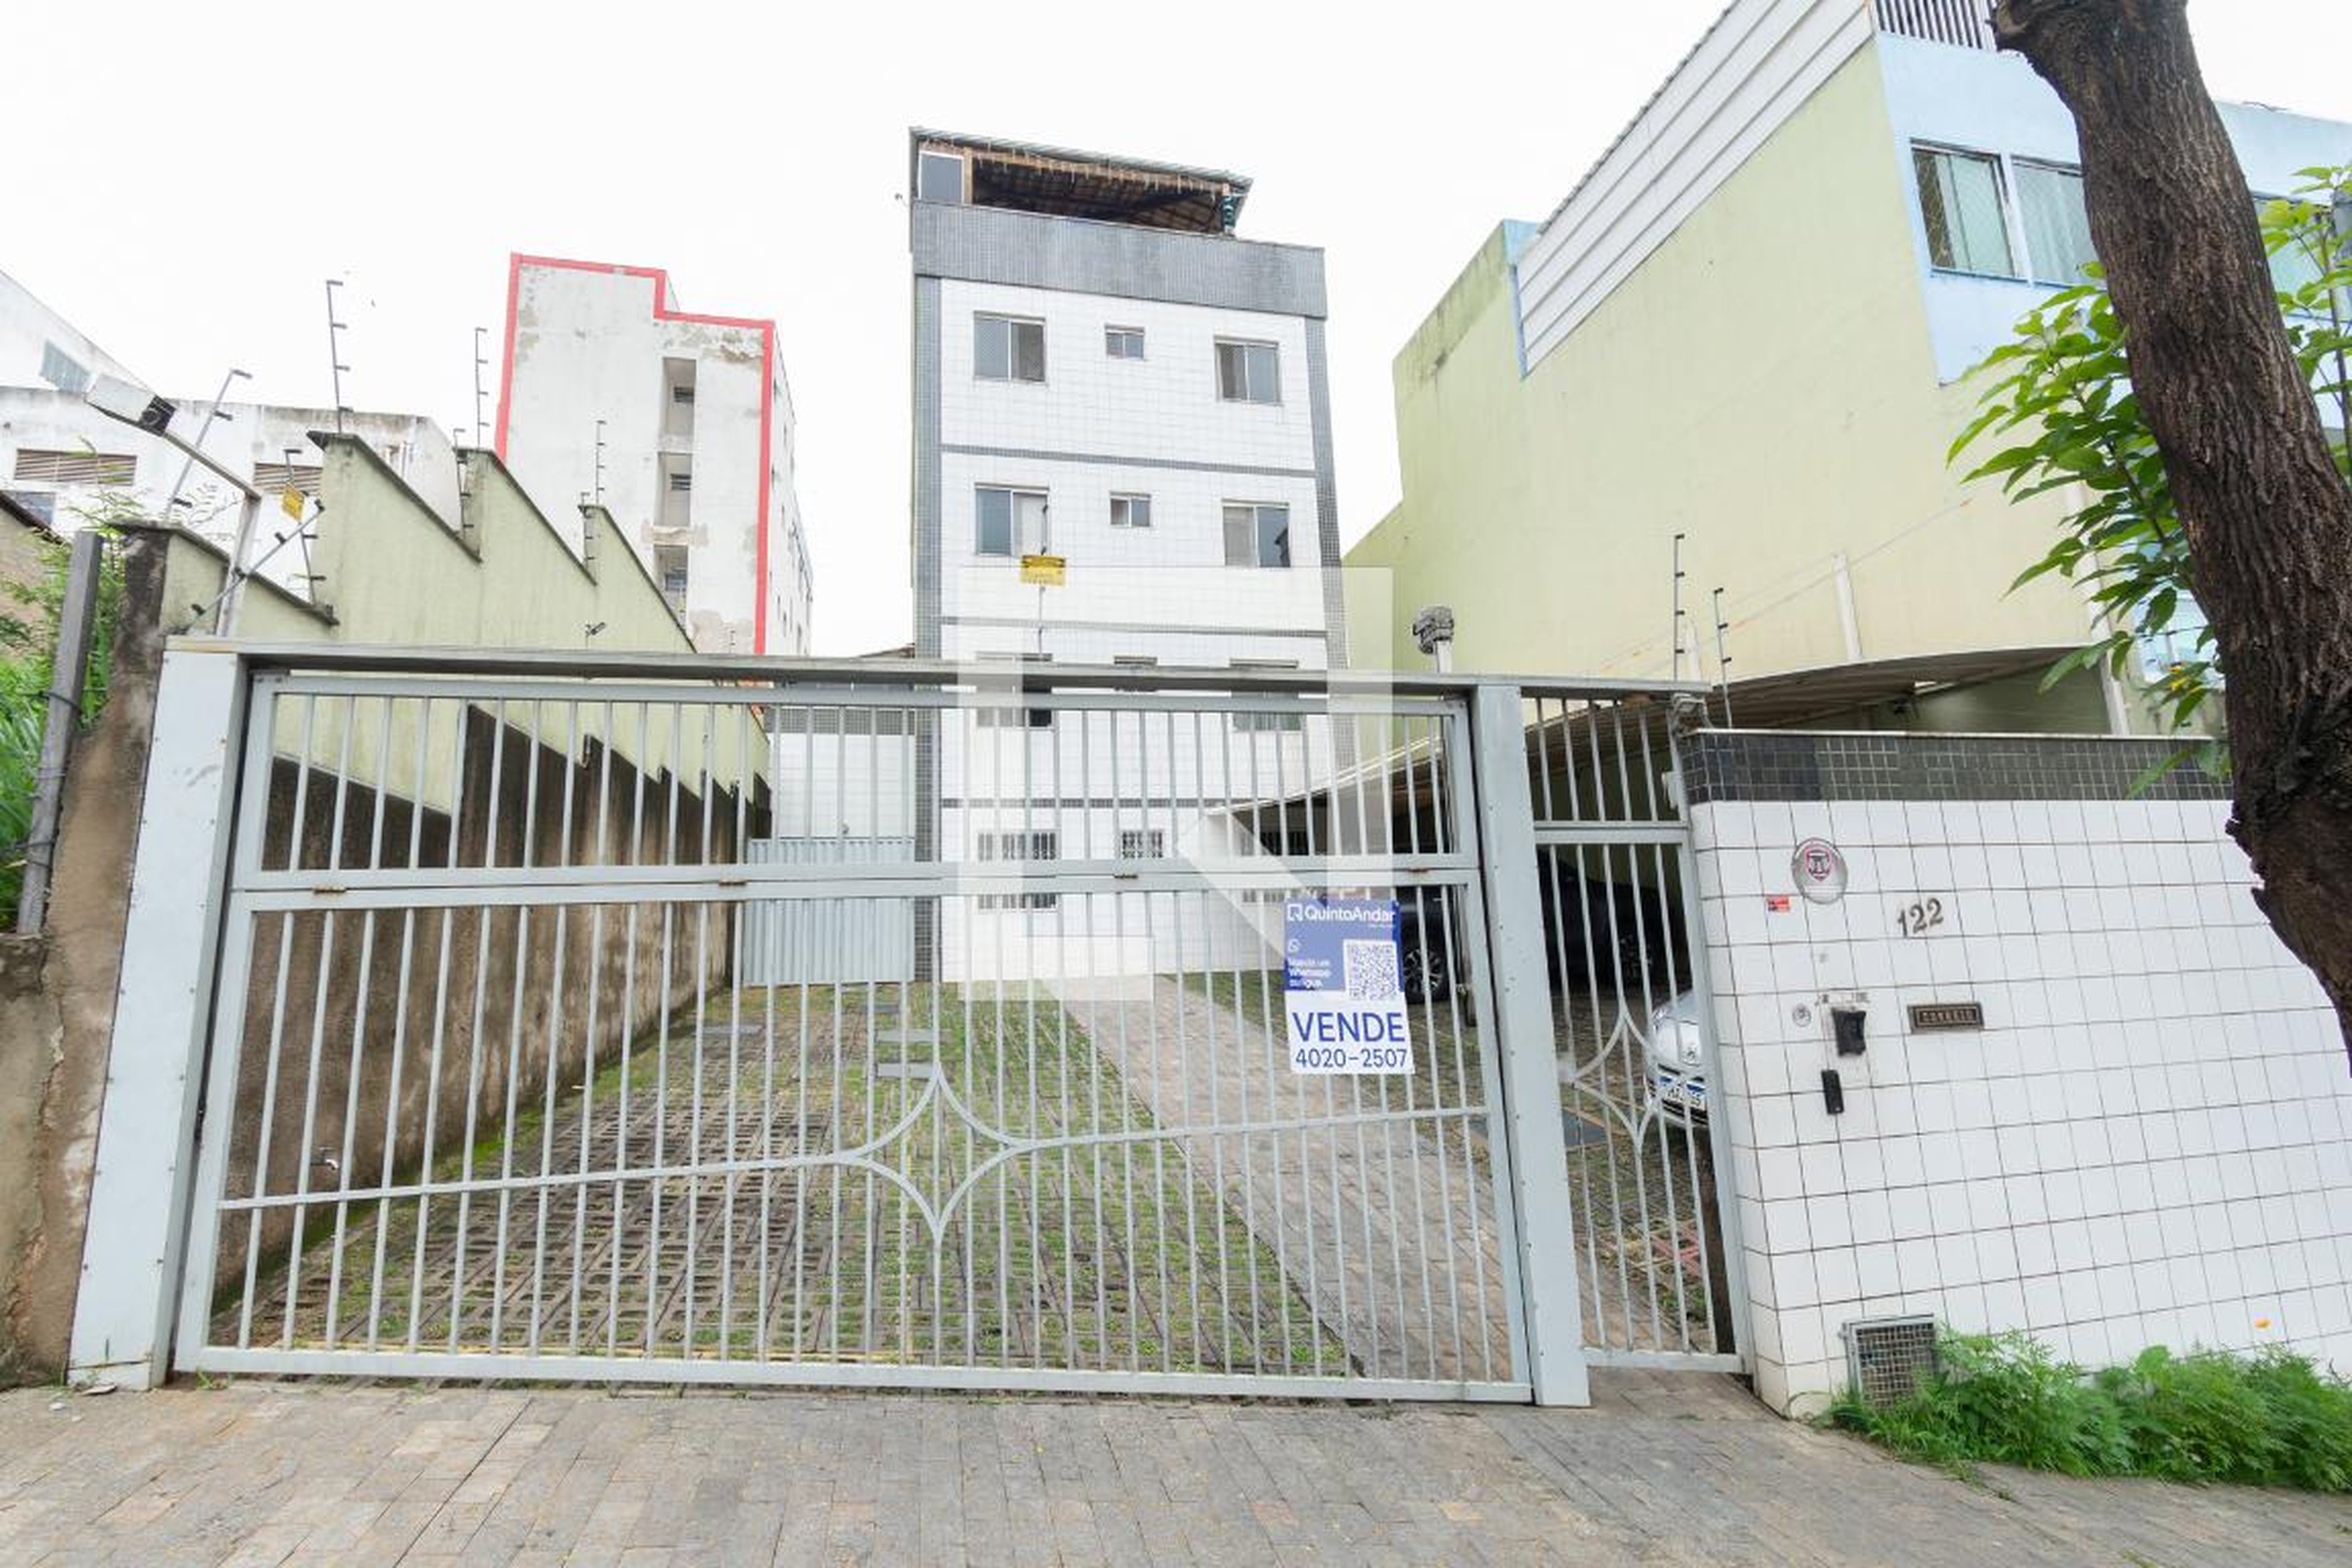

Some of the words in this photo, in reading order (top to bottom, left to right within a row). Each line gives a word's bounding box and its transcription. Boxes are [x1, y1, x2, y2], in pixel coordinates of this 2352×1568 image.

[1305, 903, 1395, 922] QuintoAndar
[1897, 897, 1944, 937] 122
[1292, 1012, 1405, 1042] VENDE
[1295, 1048, 1407, 1068] 4020-2507
